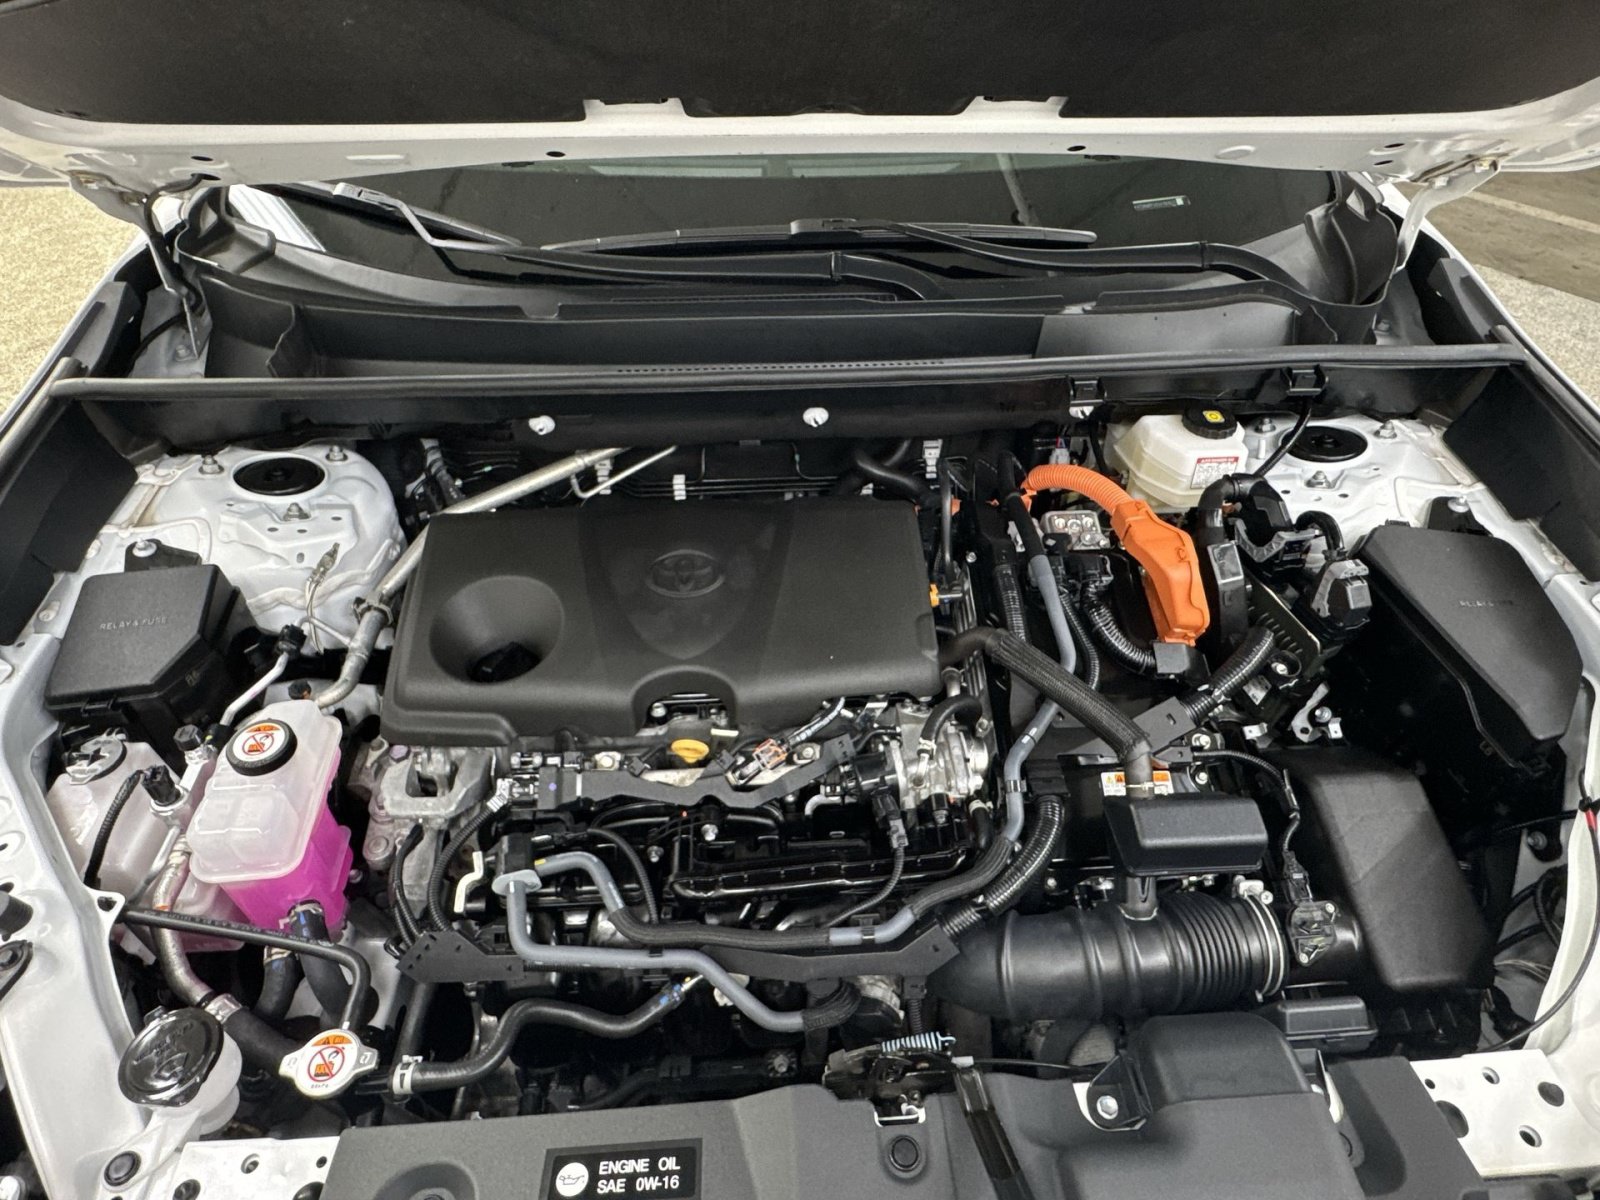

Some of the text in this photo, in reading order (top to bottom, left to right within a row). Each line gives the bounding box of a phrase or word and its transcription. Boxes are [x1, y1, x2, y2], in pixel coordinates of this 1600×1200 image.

[100, 620, 132, 630] RELAY
[599, 1156, 681, 1175] ENGINE OIL
[597, 1175, 680, 1194] SAE 0W-16
